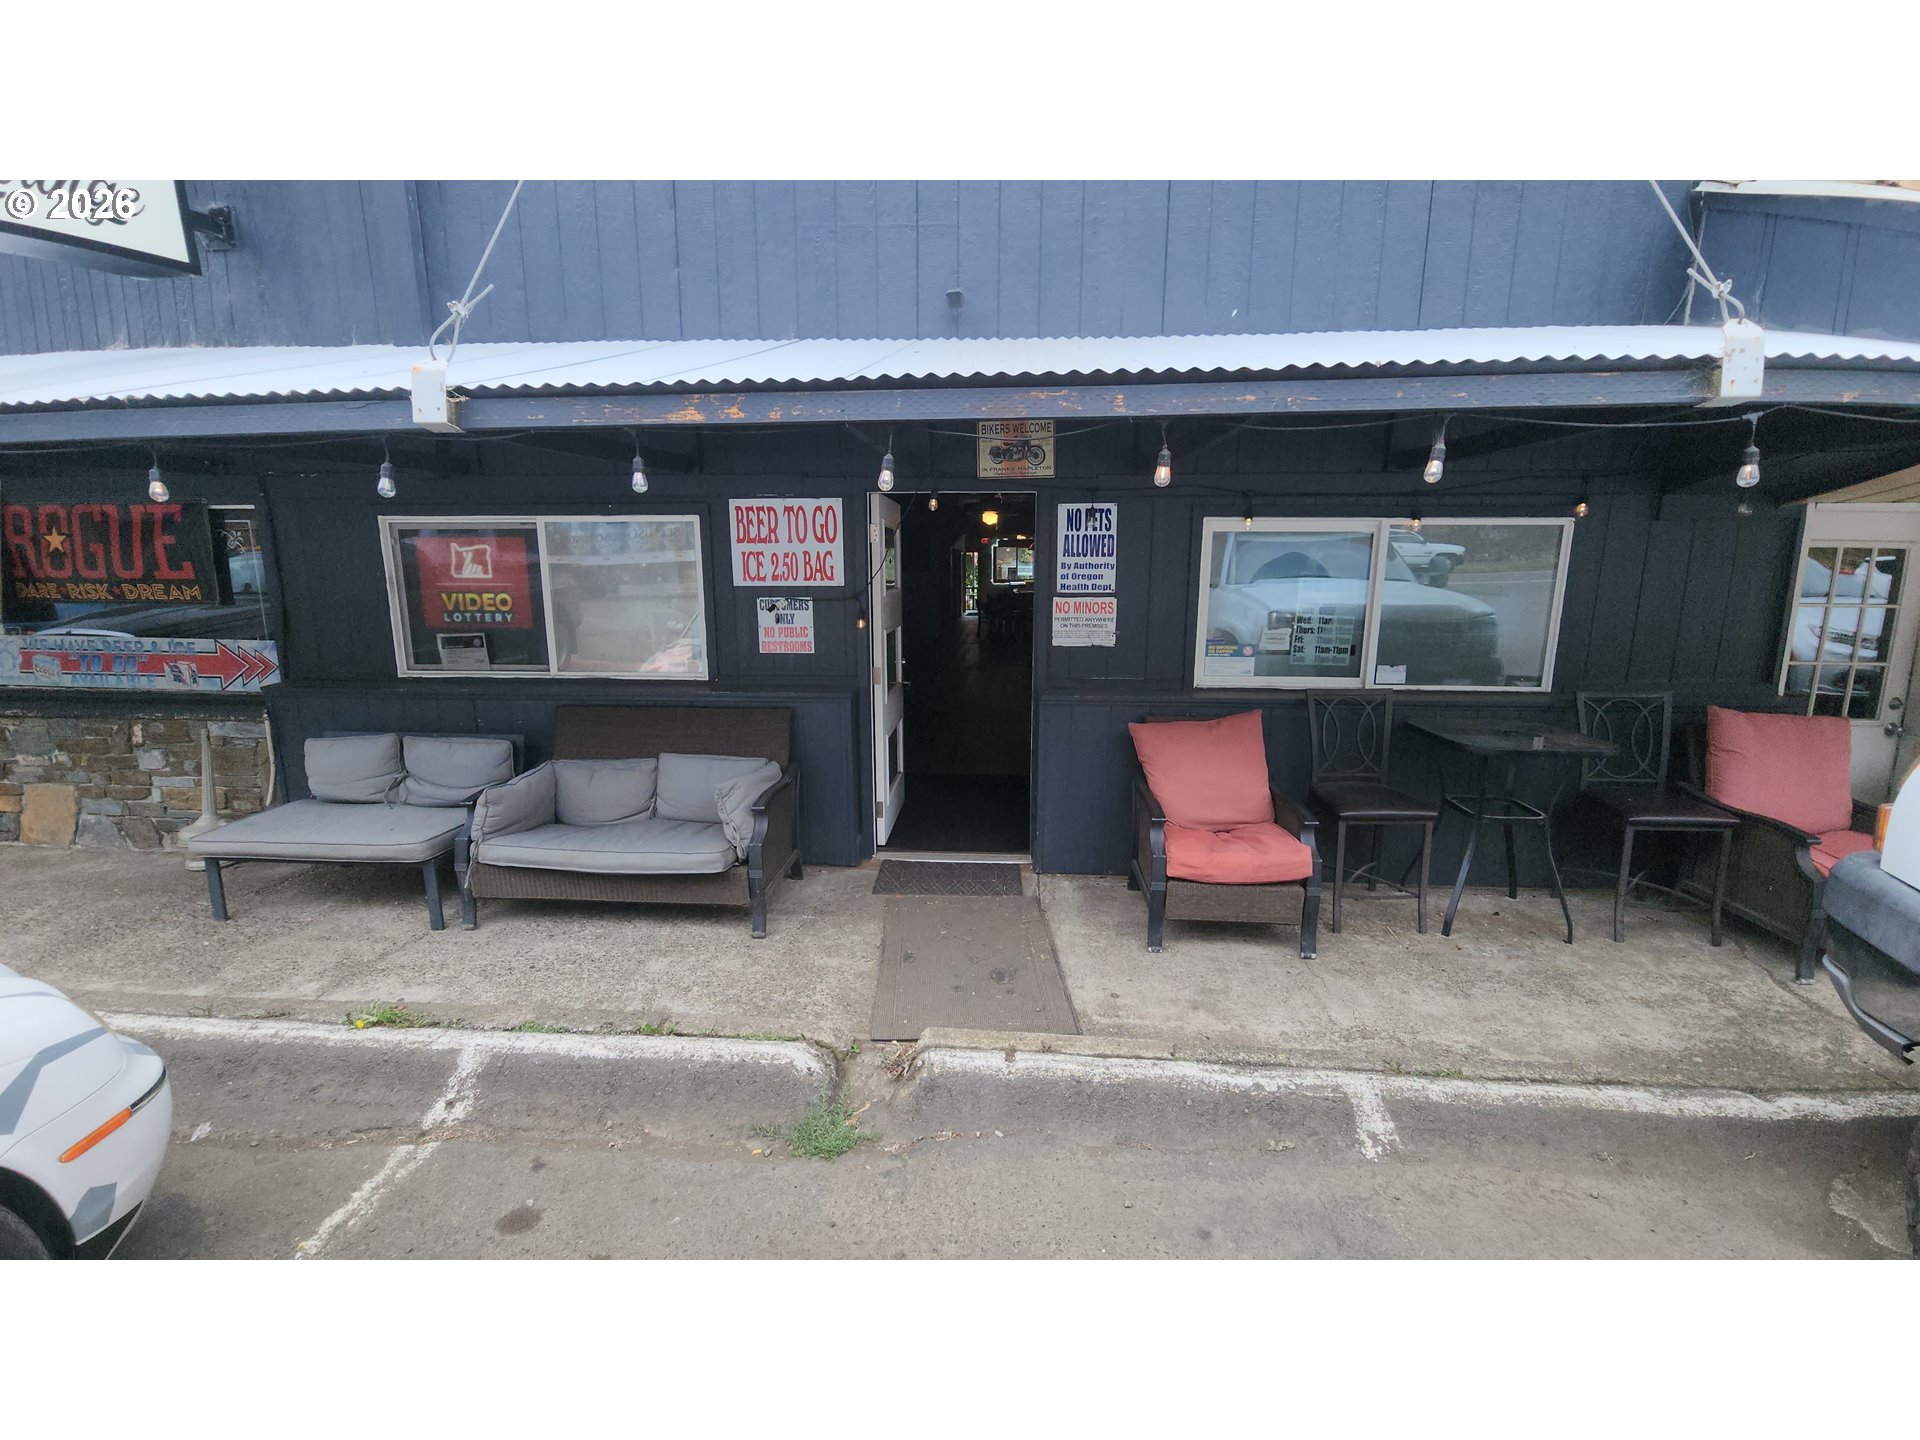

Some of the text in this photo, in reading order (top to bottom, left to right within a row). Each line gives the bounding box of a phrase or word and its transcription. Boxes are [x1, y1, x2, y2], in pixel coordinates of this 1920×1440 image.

[981, 422, 1052, 434] BIKERS WELCOME
[735, 505, 779, 545] BEER
[783, 505, 808, 544] TO
[812, 505, 837, 544] GO
[1067, 508, 1082, 532] NO
[4, 503, 196, 580] ROGUE
[1063, 534, 1115, 558] ALLOWED
[741, 550, 835, 582] ICE 2.50 BAG
[1060, 562, 1115, 571] By Authority
[1071, 573, 1104, 582] Oregon
[16, 583, 202, 600] DARE RISK DREAM
[1060, 583, 1090, 591] Health
[441, 592, 513, 611] VIDEO
[1055, 601, 1114, 615] NO MINORS
[443, 612, 513, 622] LOTTERY
[774, 613, 795, 625] ONLY
[764, 626, 809, 639] NO PUBLIC
[1296, 625, 1316, 634] Thurs:
[761, 640, 813, 652] RESTROOMS
[1292, 644, 1306, 653] Sat:
